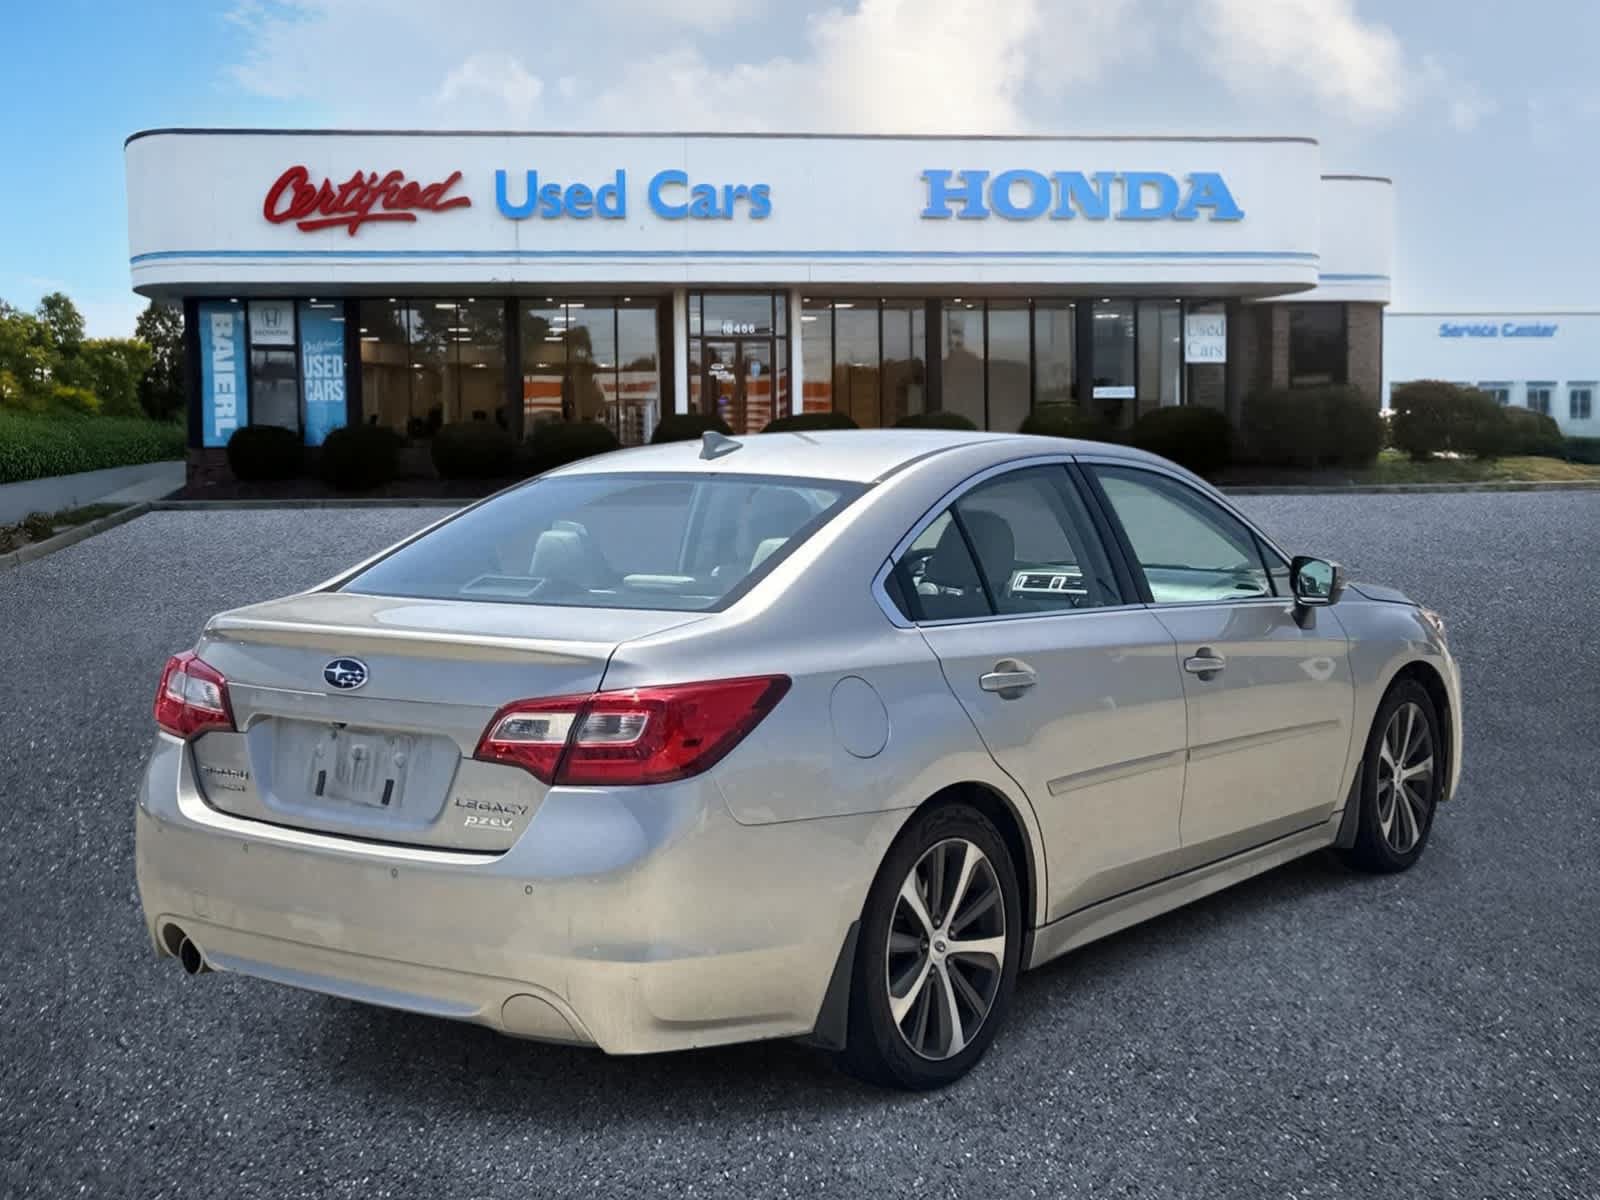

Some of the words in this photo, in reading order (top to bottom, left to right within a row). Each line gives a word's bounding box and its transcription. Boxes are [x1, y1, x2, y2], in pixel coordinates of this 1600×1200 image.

[264, 165, 472, 236] Certified
[495, 168, 626, 220] Used
[648, 168, 772, 220] Cars
[920, 169, 1246, 222] HONDA
[1186, 318, 1225, 337] Used
[1439, 322, 1498, 338] Service
[1502, 321, 1558, 337] Center
[1187, 342, 1225, 357] Cars
[302, 354, 343, 378] USED
[304, 379, 345, 403] CARS
[455, 798, 529, 815] LEGACY
